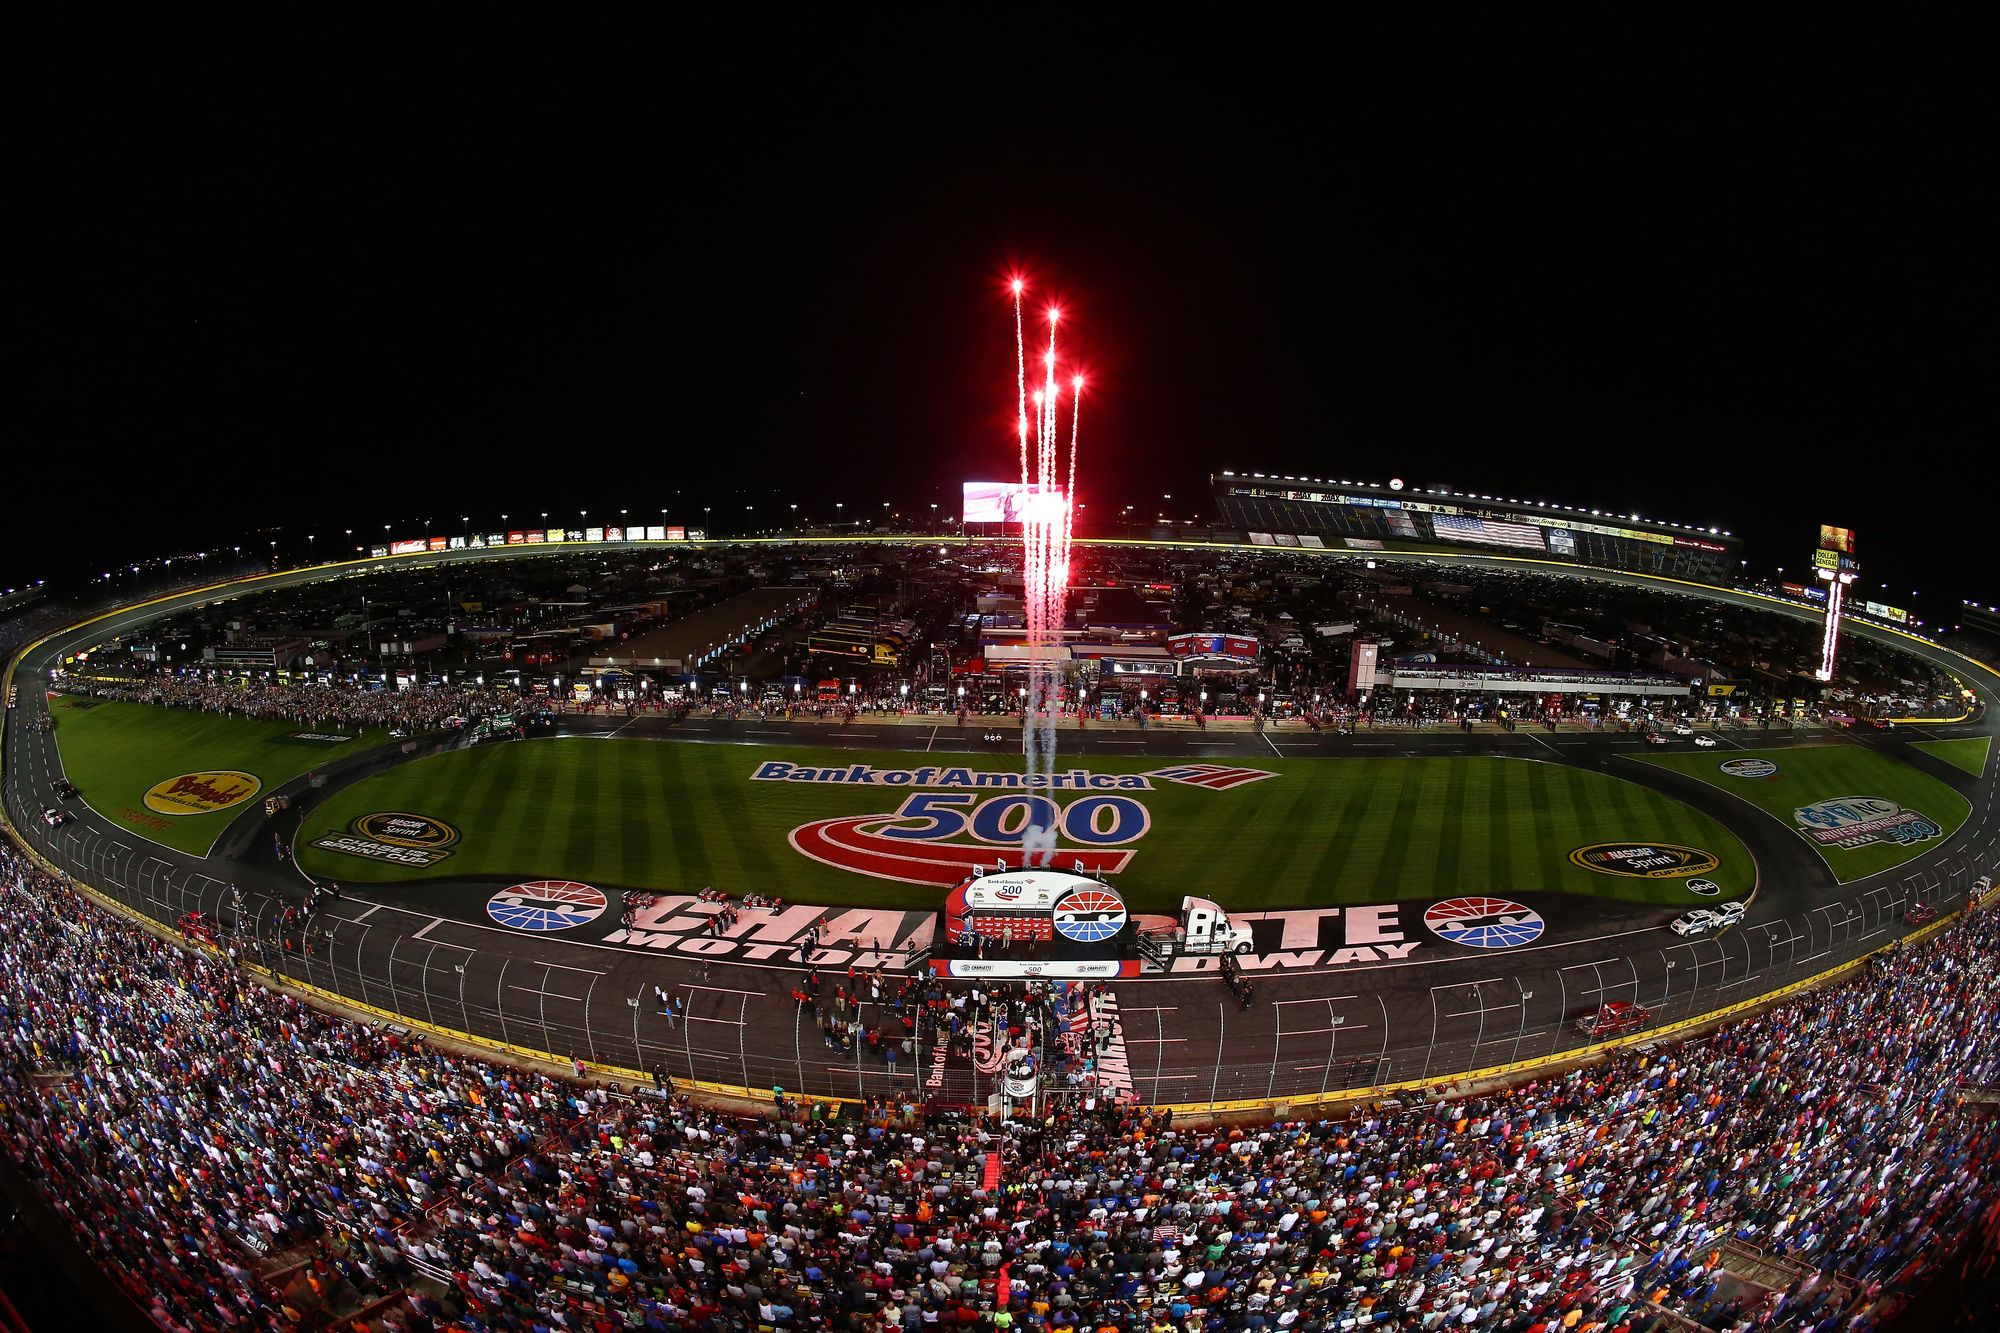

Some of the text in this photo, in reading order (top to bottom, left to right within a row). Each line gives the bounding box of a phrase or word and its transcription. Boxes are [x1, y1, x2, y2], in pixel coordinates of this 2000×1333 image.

[1816, 557, 1838, 567] GENERAL
[1817, 551, 1838, 561] DOLLAR
[751, 761, 1156, 791] Bank of America
[1852, 800, 1891, 816] NC
[388, 818, 427, 830] NASCAR
[882, 792, 1152, 845] 500
[382, 825, 421, 838] Sprint
[1813, 828, 1850, 841] DRIVE
[1851, 824, 1873, 836] FOR
[1892, 812, 1921, 825] CURE
[1883, 820, 1937, 843] 300
[319, 840, 430, 864] SPRINT CUP
[337, 837, 405, 853] CHASE
[1606, 847, 1655, 860] NASCAR
[1626, 855, 1677, 870] Sprint
[1651, 863, 1714, 877] CUP SERIES
[1002, 885, 1022, 895] 500
[1690, 882, 1716, 893] abc
[925, 1062, 944, 1087] Bank
